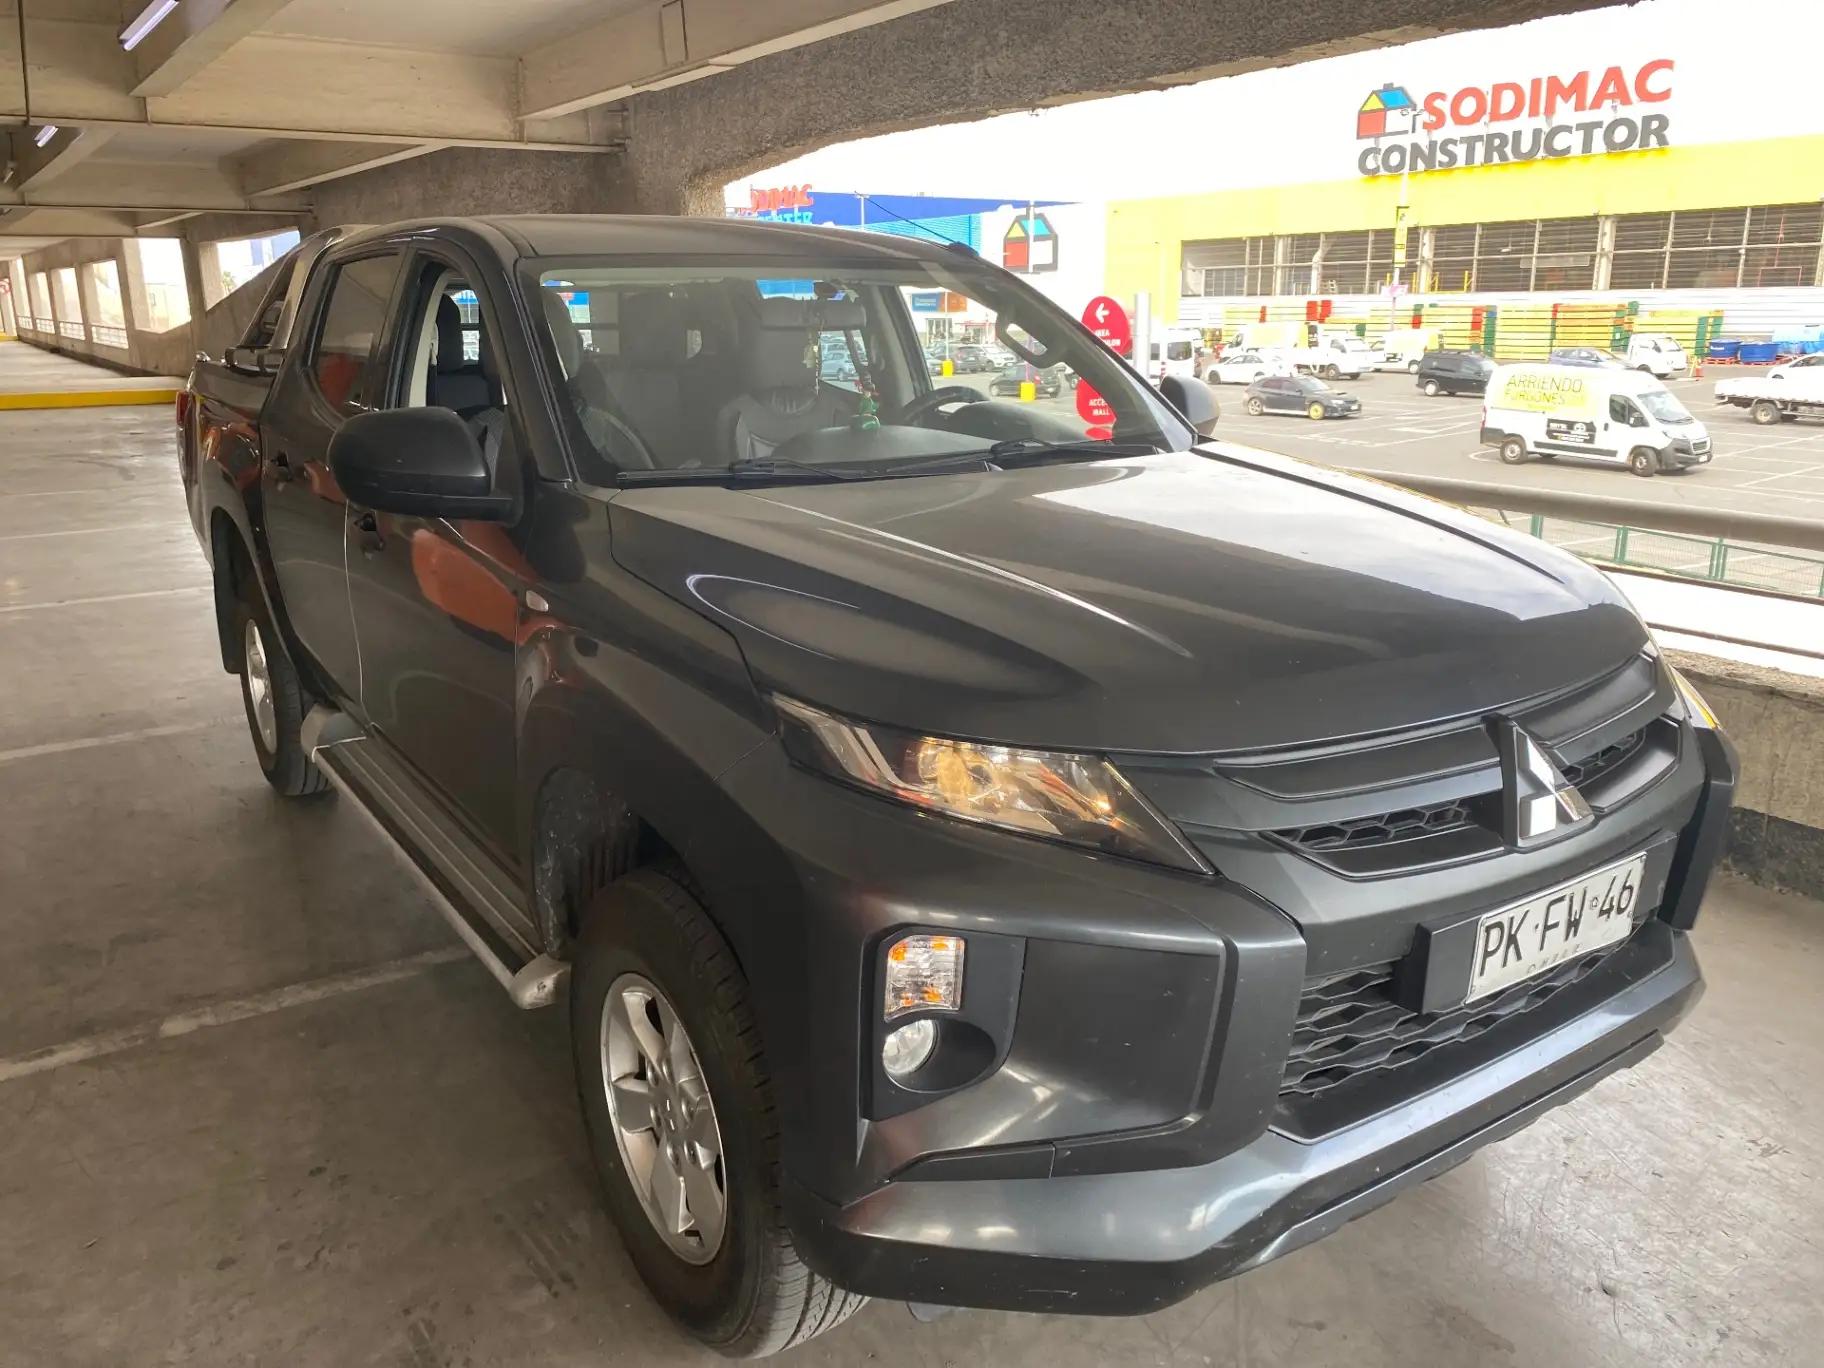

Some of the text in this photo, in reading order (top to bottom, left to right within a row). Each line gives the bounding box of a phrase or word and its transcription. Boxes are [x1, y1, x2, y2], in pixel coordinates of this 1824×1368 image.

[1422, 58, 1675, 130] SODIMAC
[1358, 113, 1670, 176] CONSTRUCTOR
[1506, 374, 1583, 393] ARRIENDO
